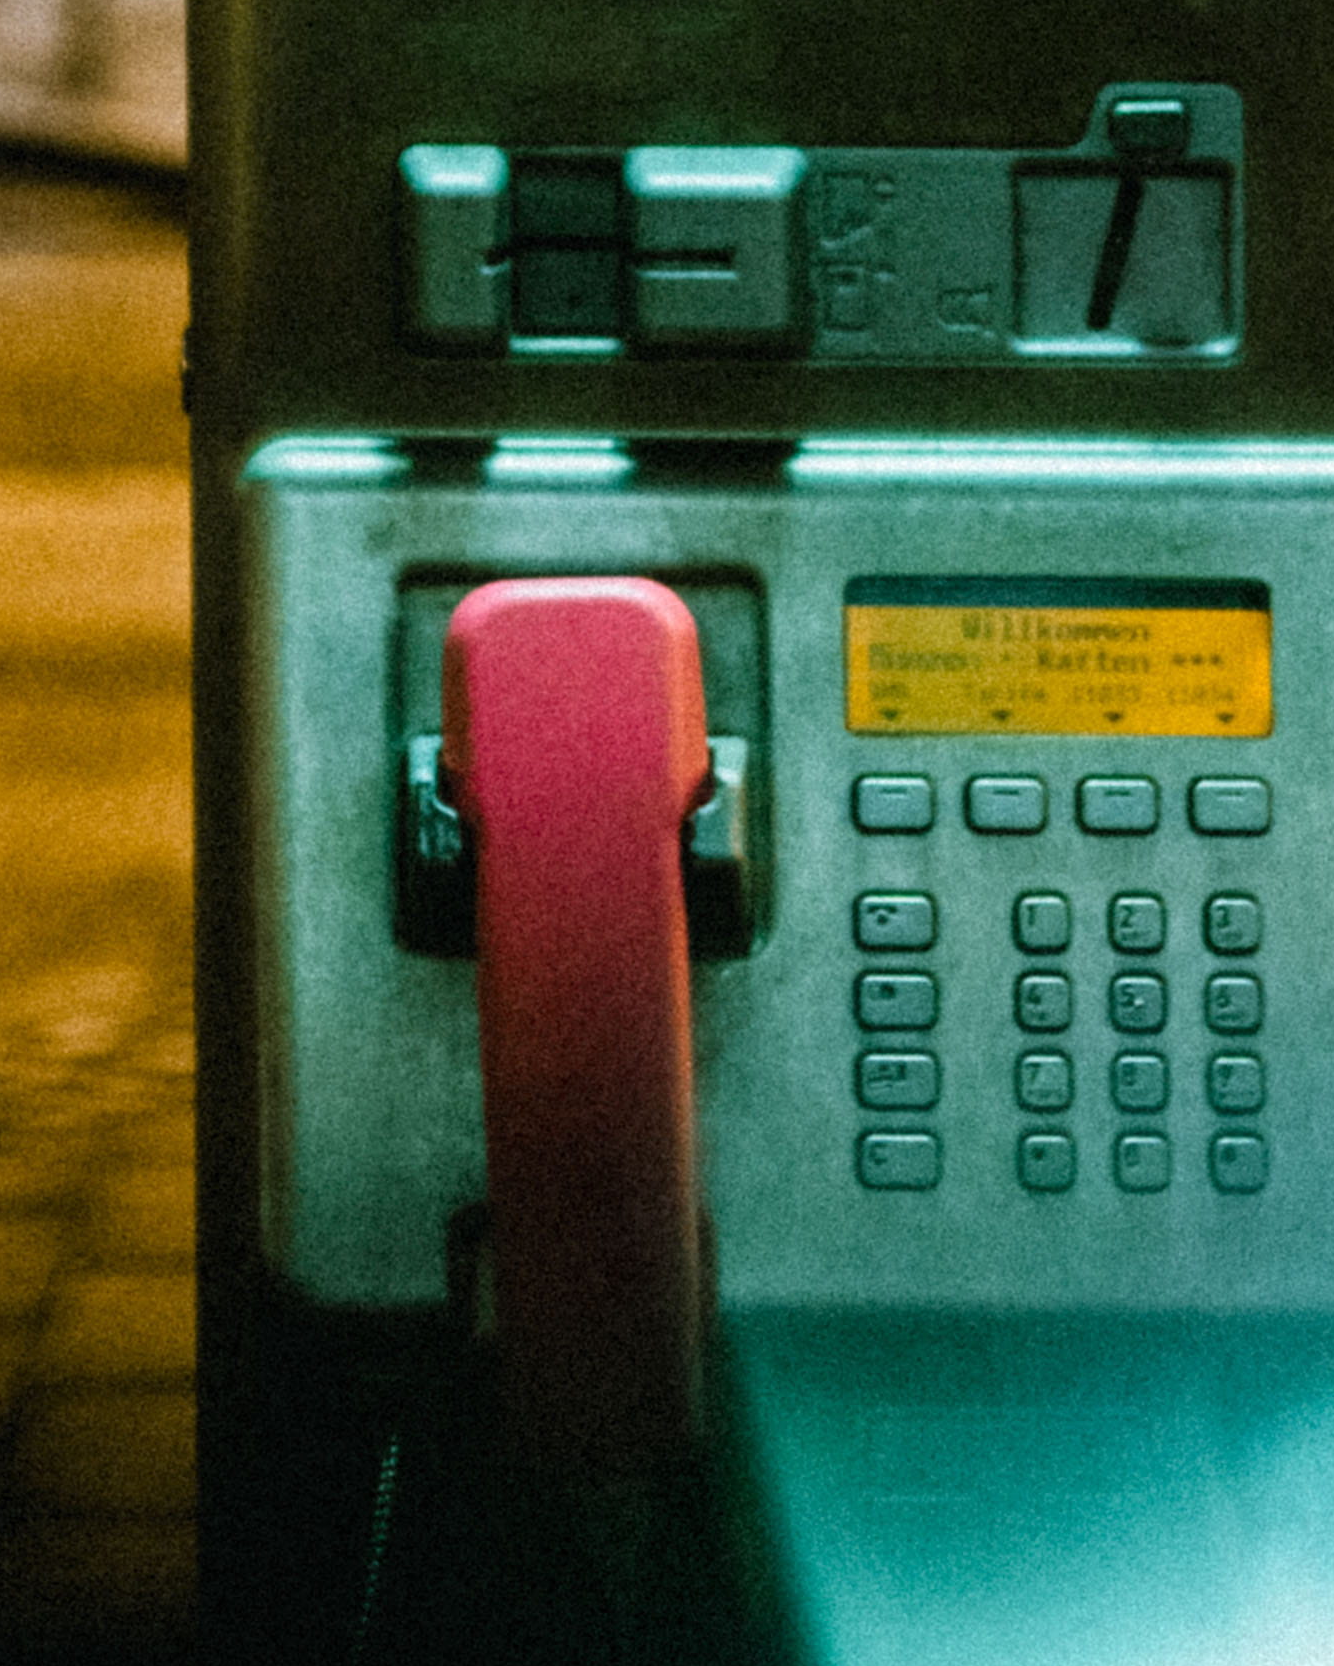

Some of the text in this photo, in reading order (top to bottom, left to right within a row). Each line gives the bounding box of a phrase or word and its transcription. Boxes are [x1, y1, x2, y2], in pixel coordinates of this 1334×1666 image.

[1119, 905, 1135, 929] 2
[1217, 905, 1231, 930] 3
[1119, 984, 1136, 1008] 5
